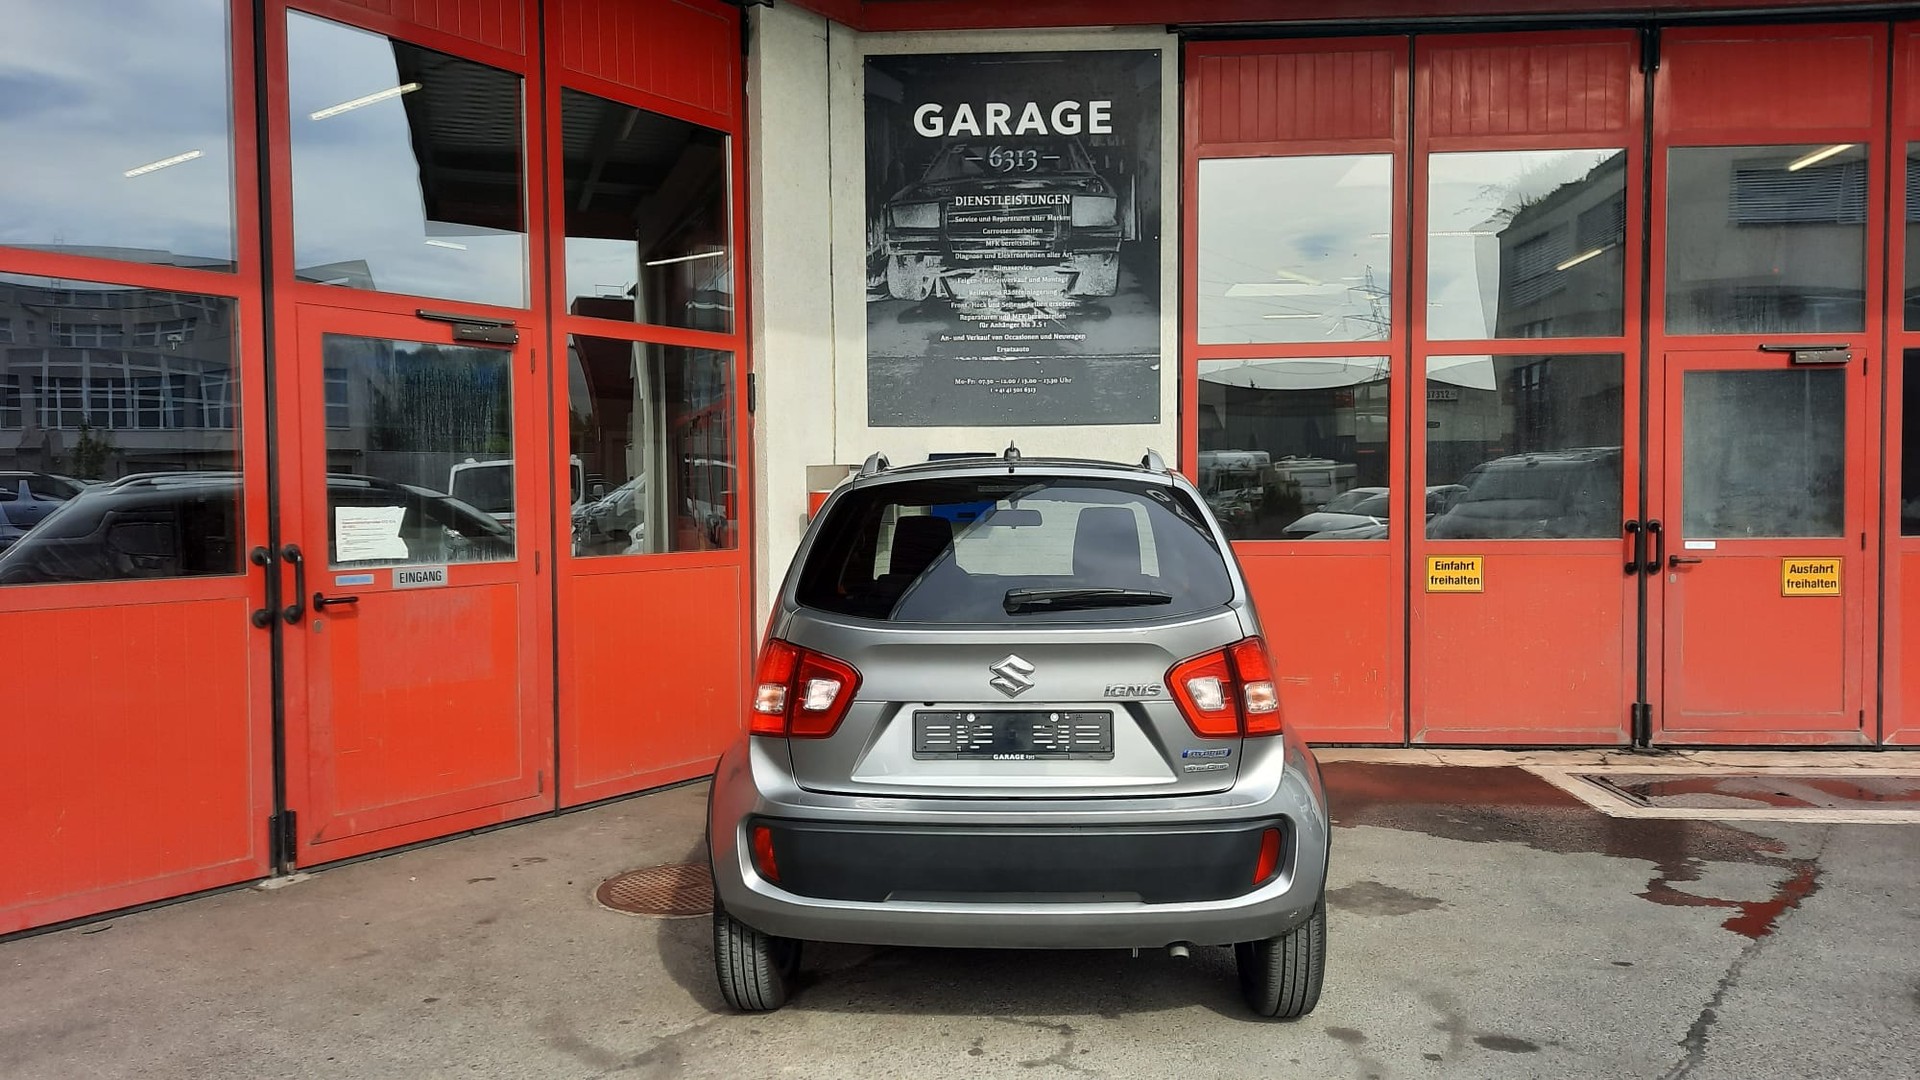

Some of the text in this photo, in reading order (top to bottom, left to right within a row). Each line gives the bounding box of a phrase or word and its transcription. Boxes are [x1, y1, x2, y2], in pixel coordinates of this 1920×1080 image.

[913, 100, 1112, 138] GARAGE
[988, 146, 1038, 172] 6313
[955, 194, 1070, 206] DIENSTLEISTUNGEN
[992, 215, 1030, 223] Reparaturen
[1435, 561, 1475, 571] Einfahrt
[1790, 564, 1834, 574] Ausfahrt
[400, 570, 442, 584] EINGANG
[1430, 576, 1480, 585] freihalten
[1787, 579, 1837, 588] freihalten
[1104, 684, 1162, 697] IGNIS
